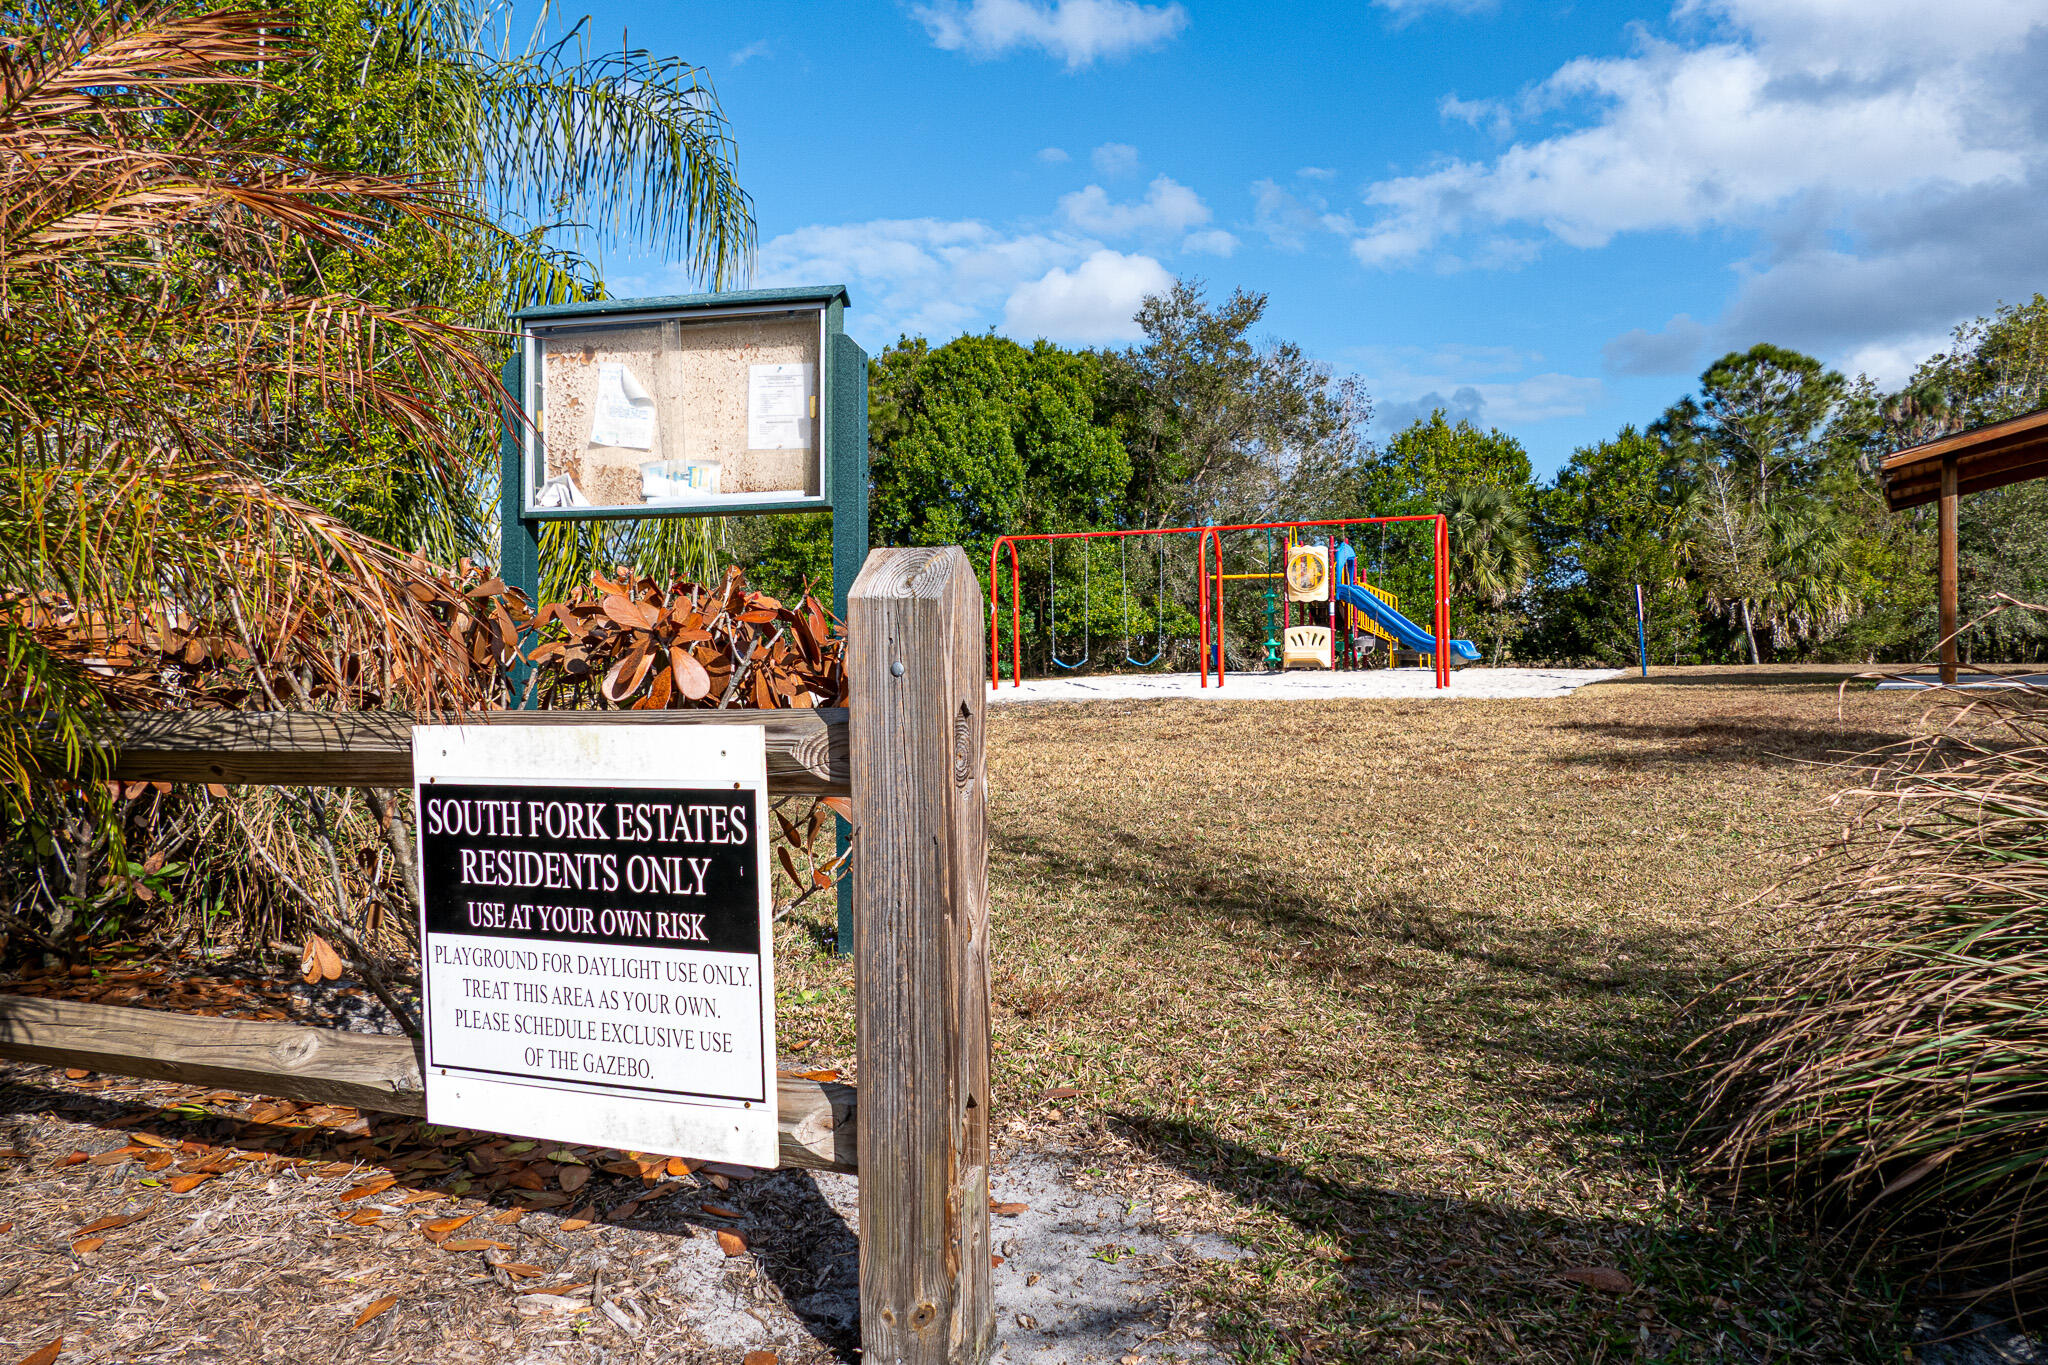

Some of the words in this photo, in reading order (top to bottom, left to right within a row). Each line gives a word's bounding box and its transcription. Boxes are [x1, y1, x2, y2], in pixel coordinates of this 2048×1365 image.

[428, 799, 522, 837] SOUTH
[529, 802, 610, 840] FORK
[616, 804, 747, 844] ESTATES
[460, 849, 618, 891] RESIDENTS
[627, 855, 712, 895] ONLY
[468, 902, 506, 928] USE
[510, 905, 536, 930] AT
[537, 906, 596, 933] YOUR
[600, 909, 652, 937] OWN
[656, 912, 708, 941] RISK
[435, 946, 538, 971] PLAYGROUND
[542, 952, 573, 974] FOR
[578, 955, 660, 981] DAYLIGHT
[666, 962, 698, 982] USE
[703, 964, 752, 987] ONLY.
[463, 978, 510, 1000] TREAT
[513, 982, 548, 1003] THIS
[553, 986, 594, 1008] AREA
[599, 990, 619, 1009] AS
[623, 991, 669, 1014] YOUR
[675, 995, 721, 1018] OWN.
[455, 1009, 509, 1032] PLEASE
[515, 1014, 596, 1040] SCHEDULE
[602, 1022, 694, 1050] EXCLUSIVE
[700, 1032, 732, 1053] USE
[525, 1047, 545, 1067] OF
[548, 1049, 578, 1071] THE
[583, 1053, 654, 1079] GAZEBO.
